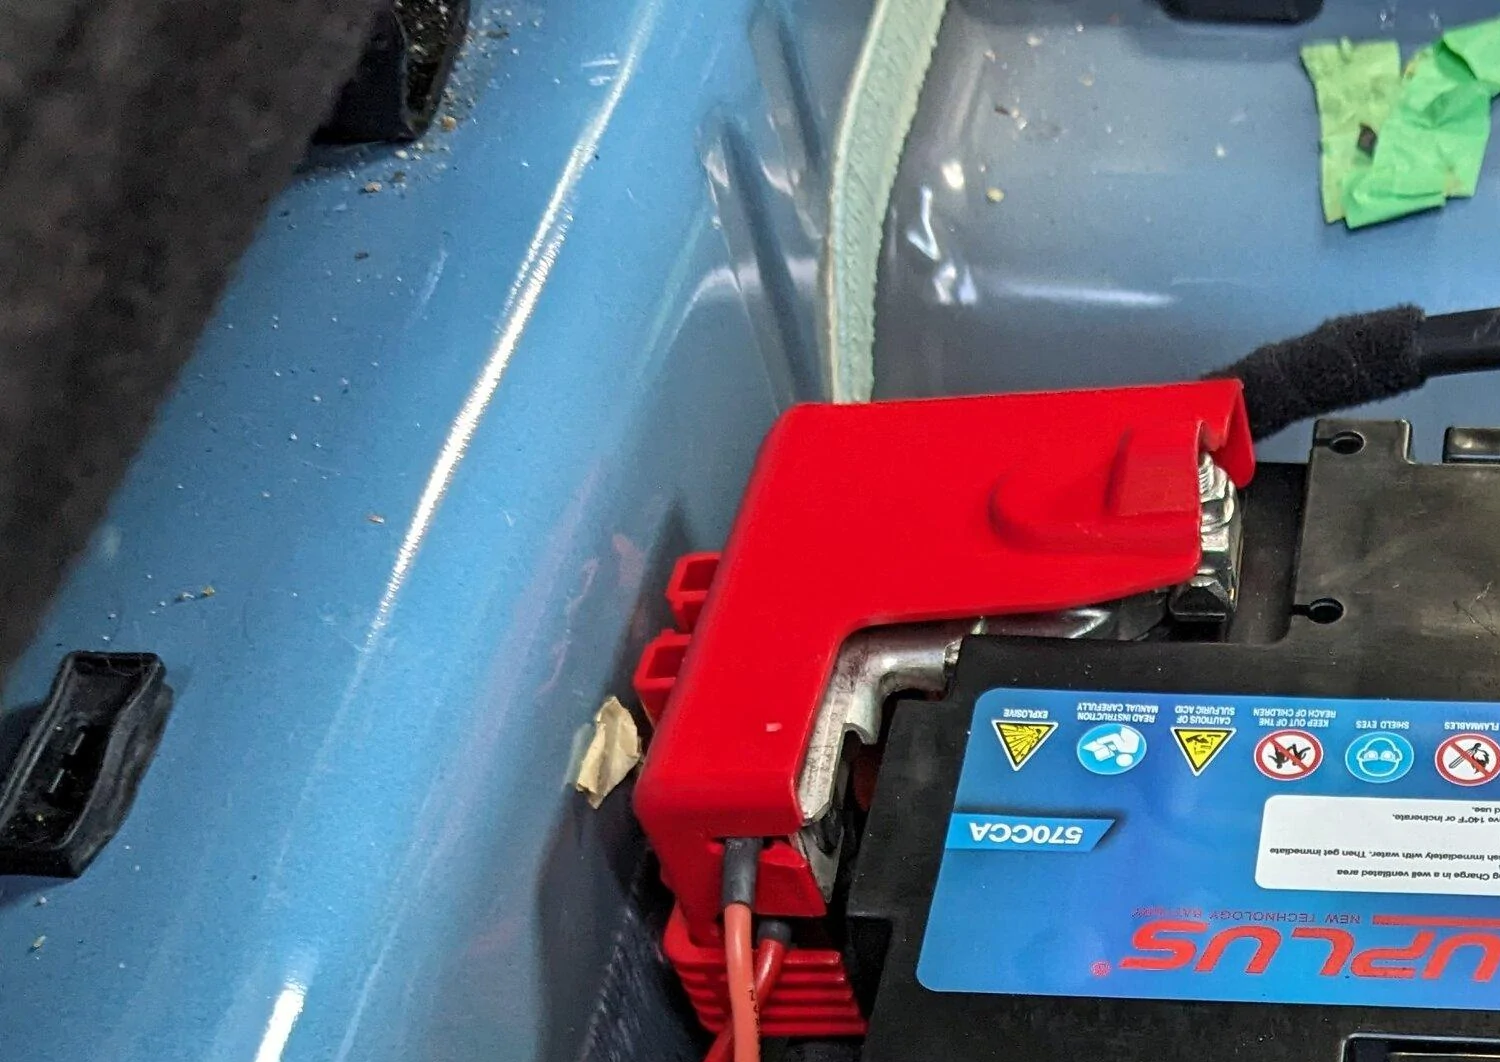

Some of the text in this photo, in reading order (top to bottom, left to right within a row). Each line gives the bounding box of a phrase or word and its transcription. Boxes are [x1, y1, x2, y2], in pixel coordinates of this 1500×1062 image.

[1076, 702, 1159, 714] MANUAL CAREFULLY
[1175, 705, 1236, 716] SULFURIC ACID
[1253, 707, 1337, 718] REACH OF CHILDREN
[1004, 708, 1048, 719] EXPLOSIVE
[1077, 712, 1156, 723] READ INSTRUCTION
[1176, 715, 1231, 725] CAUTIOUS OF
[1258, 717, 1330, 728] KEEP OUT OF THE
[1356, 720, 1410, 730] SHIELD EYES
[1444, 721, 1500, 731] FLAMMABLES
[1392, 814, 1443, 823] incinerate.
[1457, 816, 1485, 824] 140°F
[969, 822, 1083, 845] 570CCA
[1269, 848, 1322, 857] immediate
[1323, 847, 1340, 857] get
[1342, 850, 1367, 858] Then
[1368, 850, 1400, 859] water.
[1402, 851, 1423, 860] with
[1425, 850, 1485, 862] immediately
[1361, 869, 1409, 878] ventilated
[1411, 871, 1431, 879] well
[1442, 872, 1451, 880] in
[1453, 870, 1490, 881] Charge
[1131, 906, 1360, 925] NEW TECHNOLOGY BATRY
